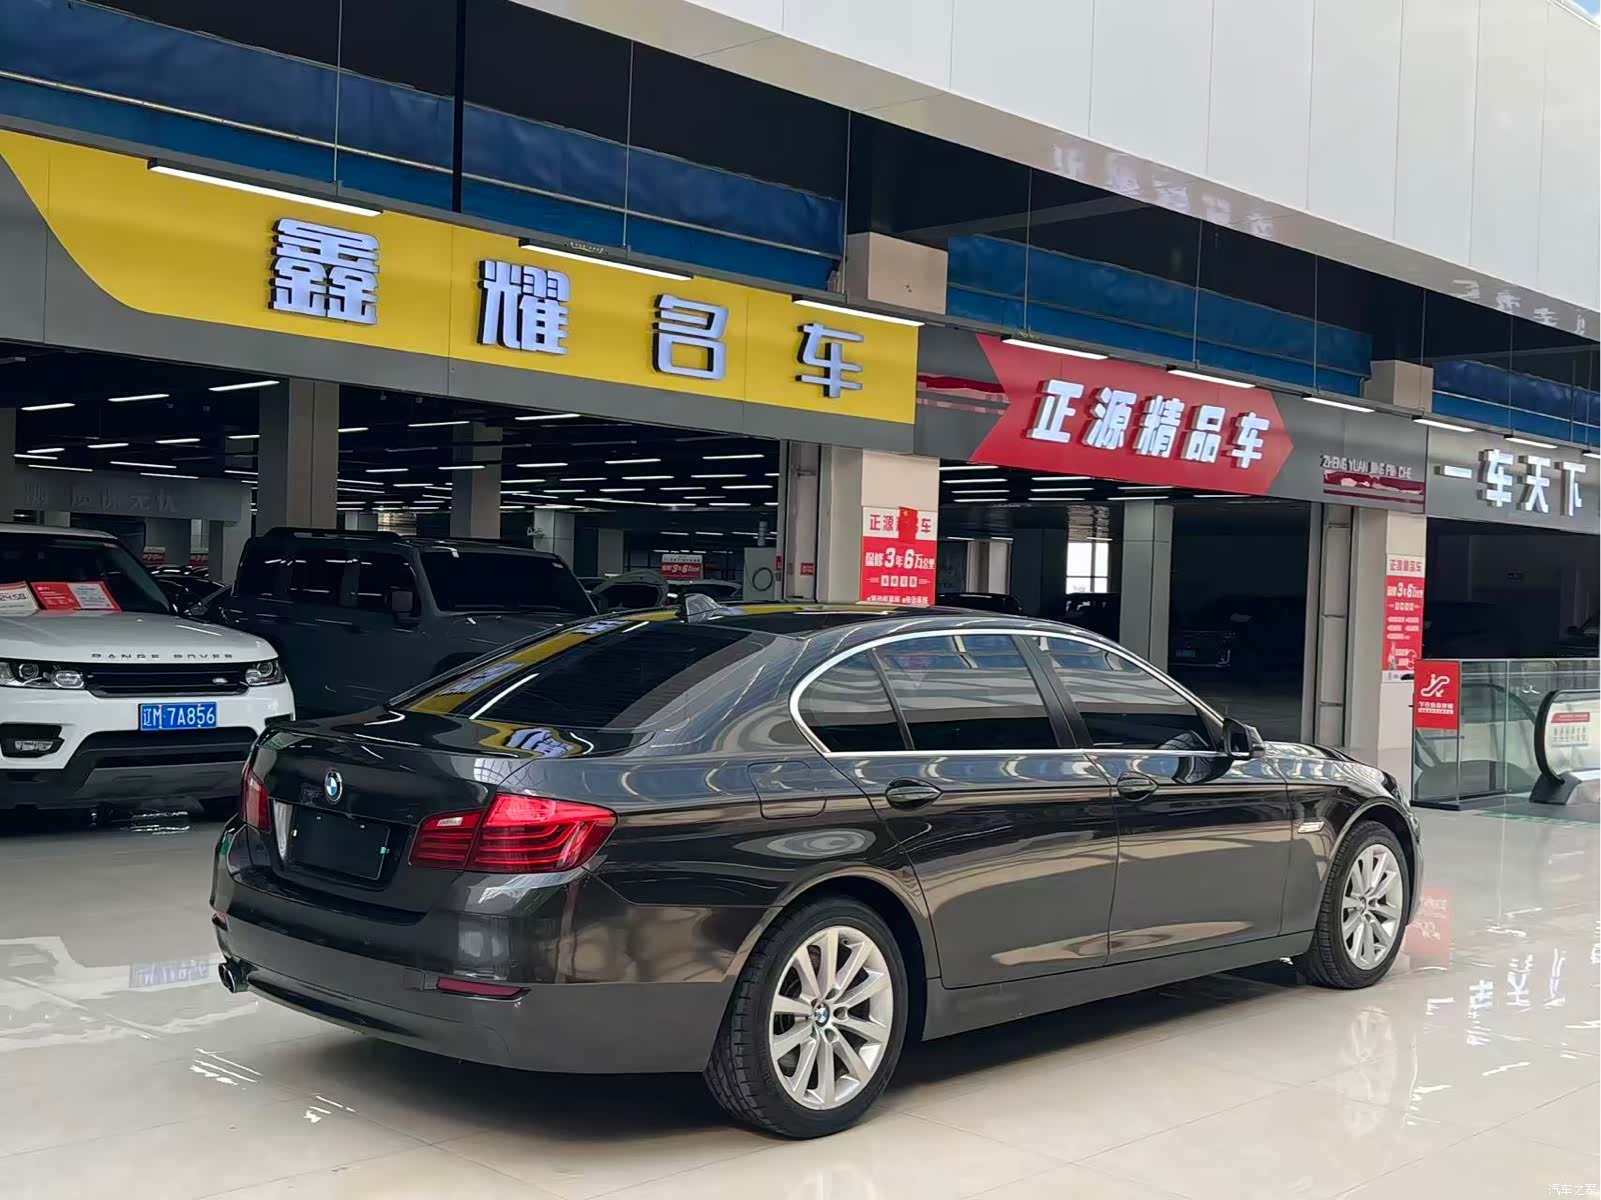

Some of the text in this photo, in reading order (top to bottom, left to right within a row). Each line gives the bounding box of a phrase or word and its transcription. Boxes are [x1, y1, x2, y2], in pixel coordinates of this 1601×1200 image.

[268, 216, 865, 399] 鑫耀名车
[1027, 378, 1270, 469] 正源精品车
[1348, 458, 1368, 473] YUAN
[1385, 463, 1397, 477] PIN
[1398, 465, 1412, 479] CHE
[1434, 448, 1587, 517] 一车天下
[869, 513, 931, 534] 正源车
